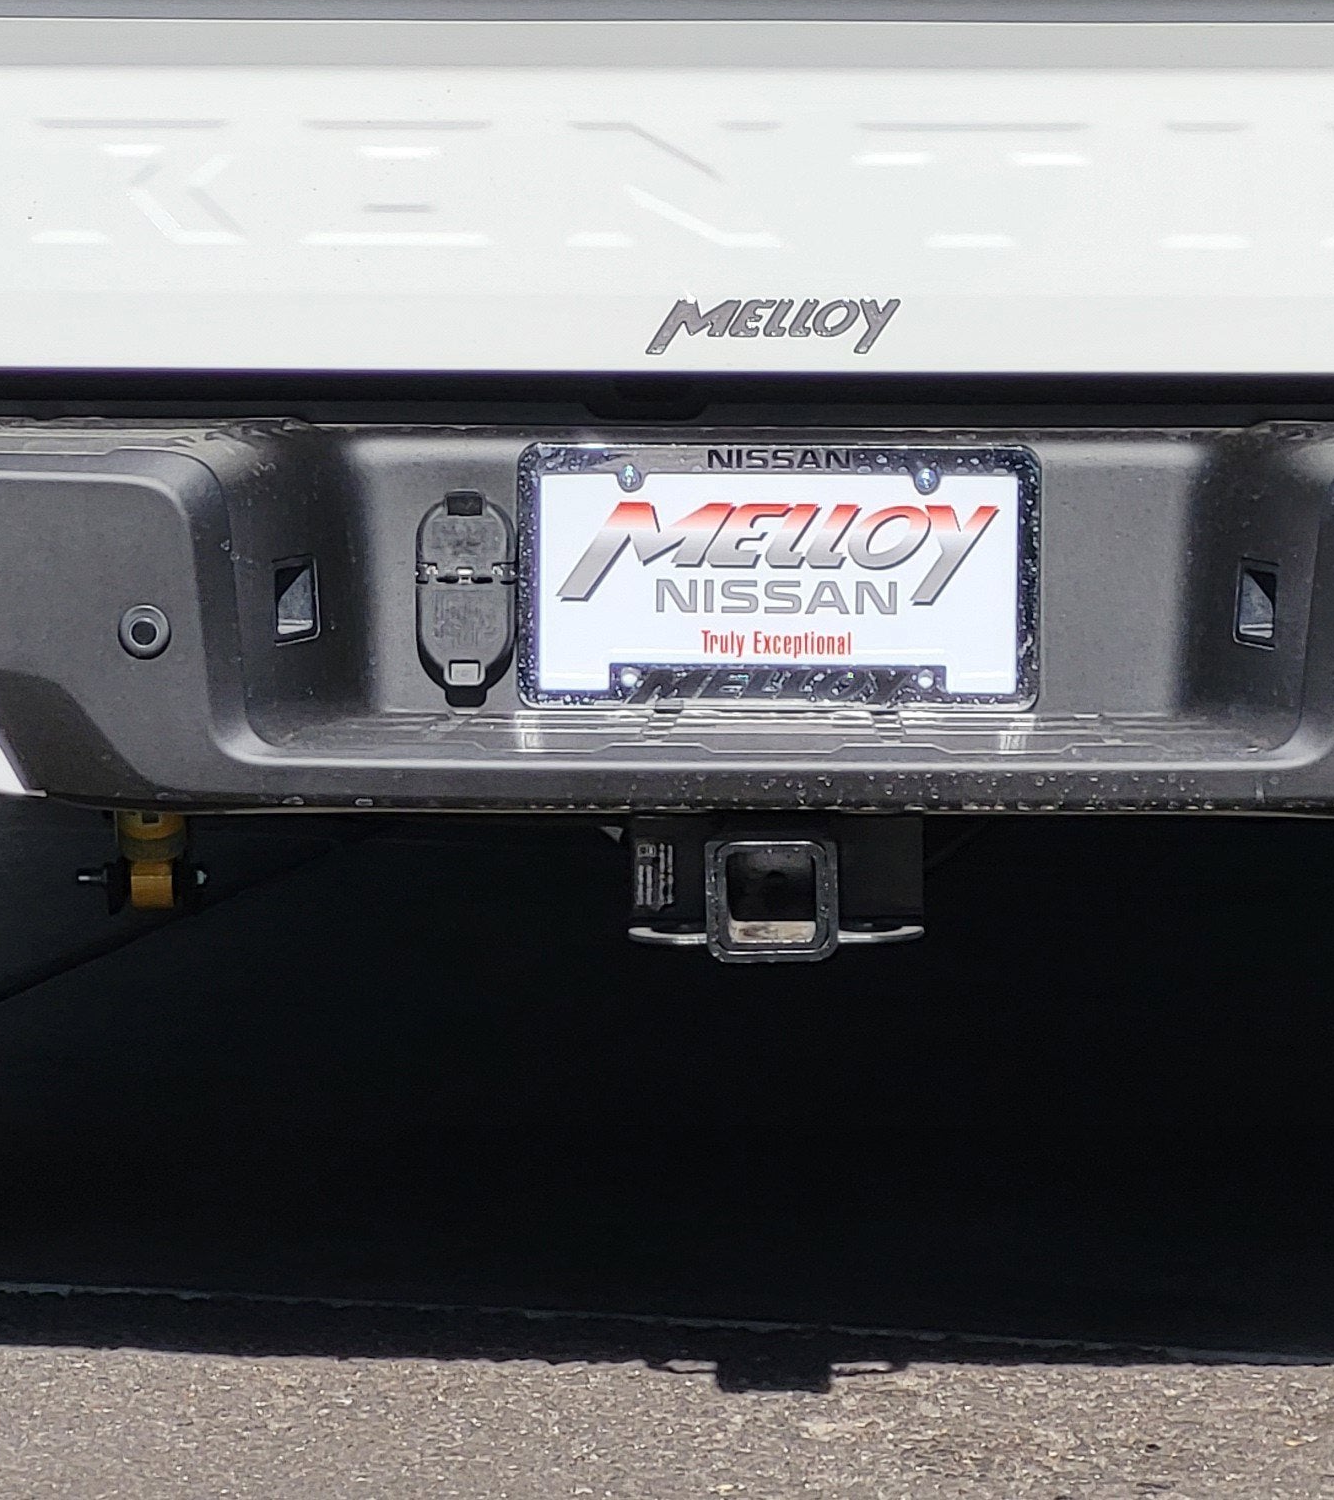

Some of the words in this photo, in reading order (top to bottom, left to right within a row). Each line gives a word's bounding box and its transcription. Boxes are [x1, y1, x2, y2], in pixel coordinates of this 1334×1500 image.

[645, 298, 901, 355] MELLOY
[707, 449, 852, 469] NISSAN
[556, 501, 999, 606] MELLOY
[655, 578, 898, 615] NISSAN
[701, 630, 745, 656] Truly
[753, 631, 853, 657] Exceptional
